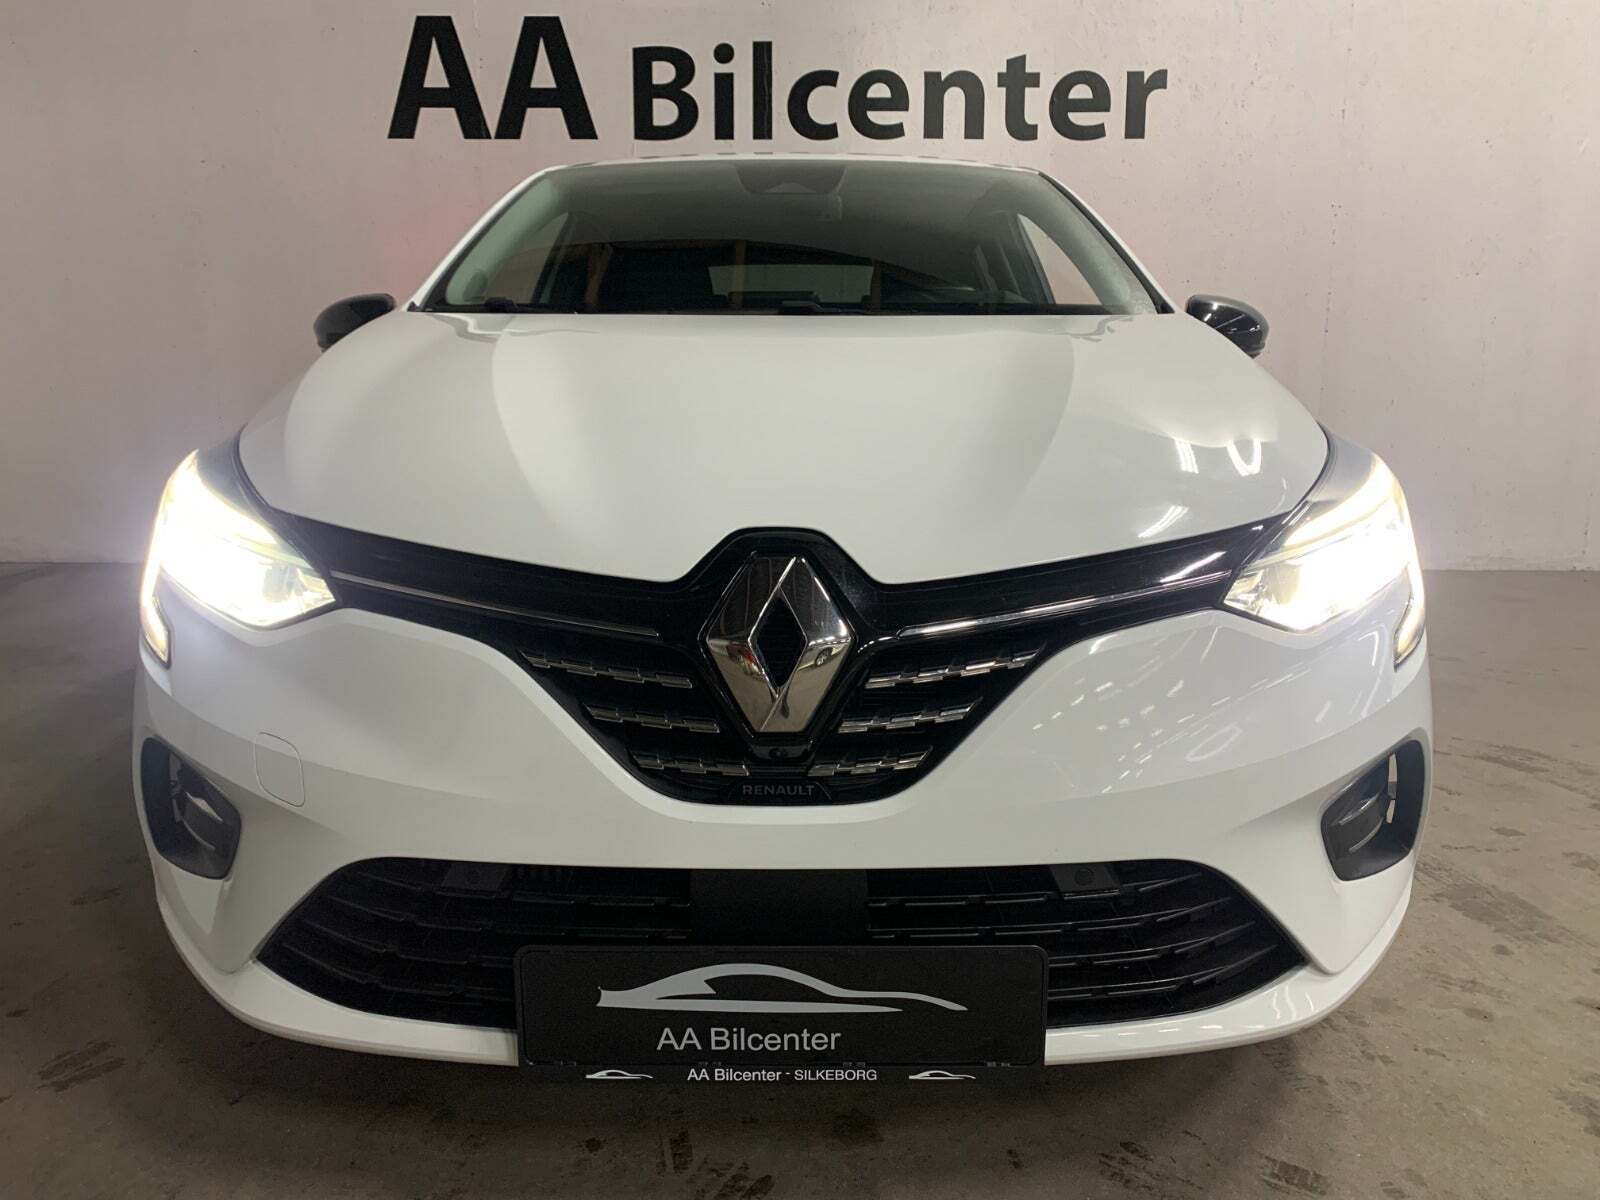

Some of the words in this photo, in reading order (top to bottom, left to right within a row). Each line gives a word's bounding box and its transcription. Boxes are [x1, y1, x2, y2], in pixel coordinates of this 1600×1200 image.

[387, 15, 598, 140] AA
[632, 41, 1168, 141] Bilcenter
[742, 784, 815, 796] RENAULT
[656, 1027, 701, 1051] AA
[711, 1027, 841, 1051] Bilcenter
[687, 1068, 709, 1082] AA
[714, 1068, 781, 1082] Bilcenter
[794, 1068, 878, 1082] SILKEBORG
